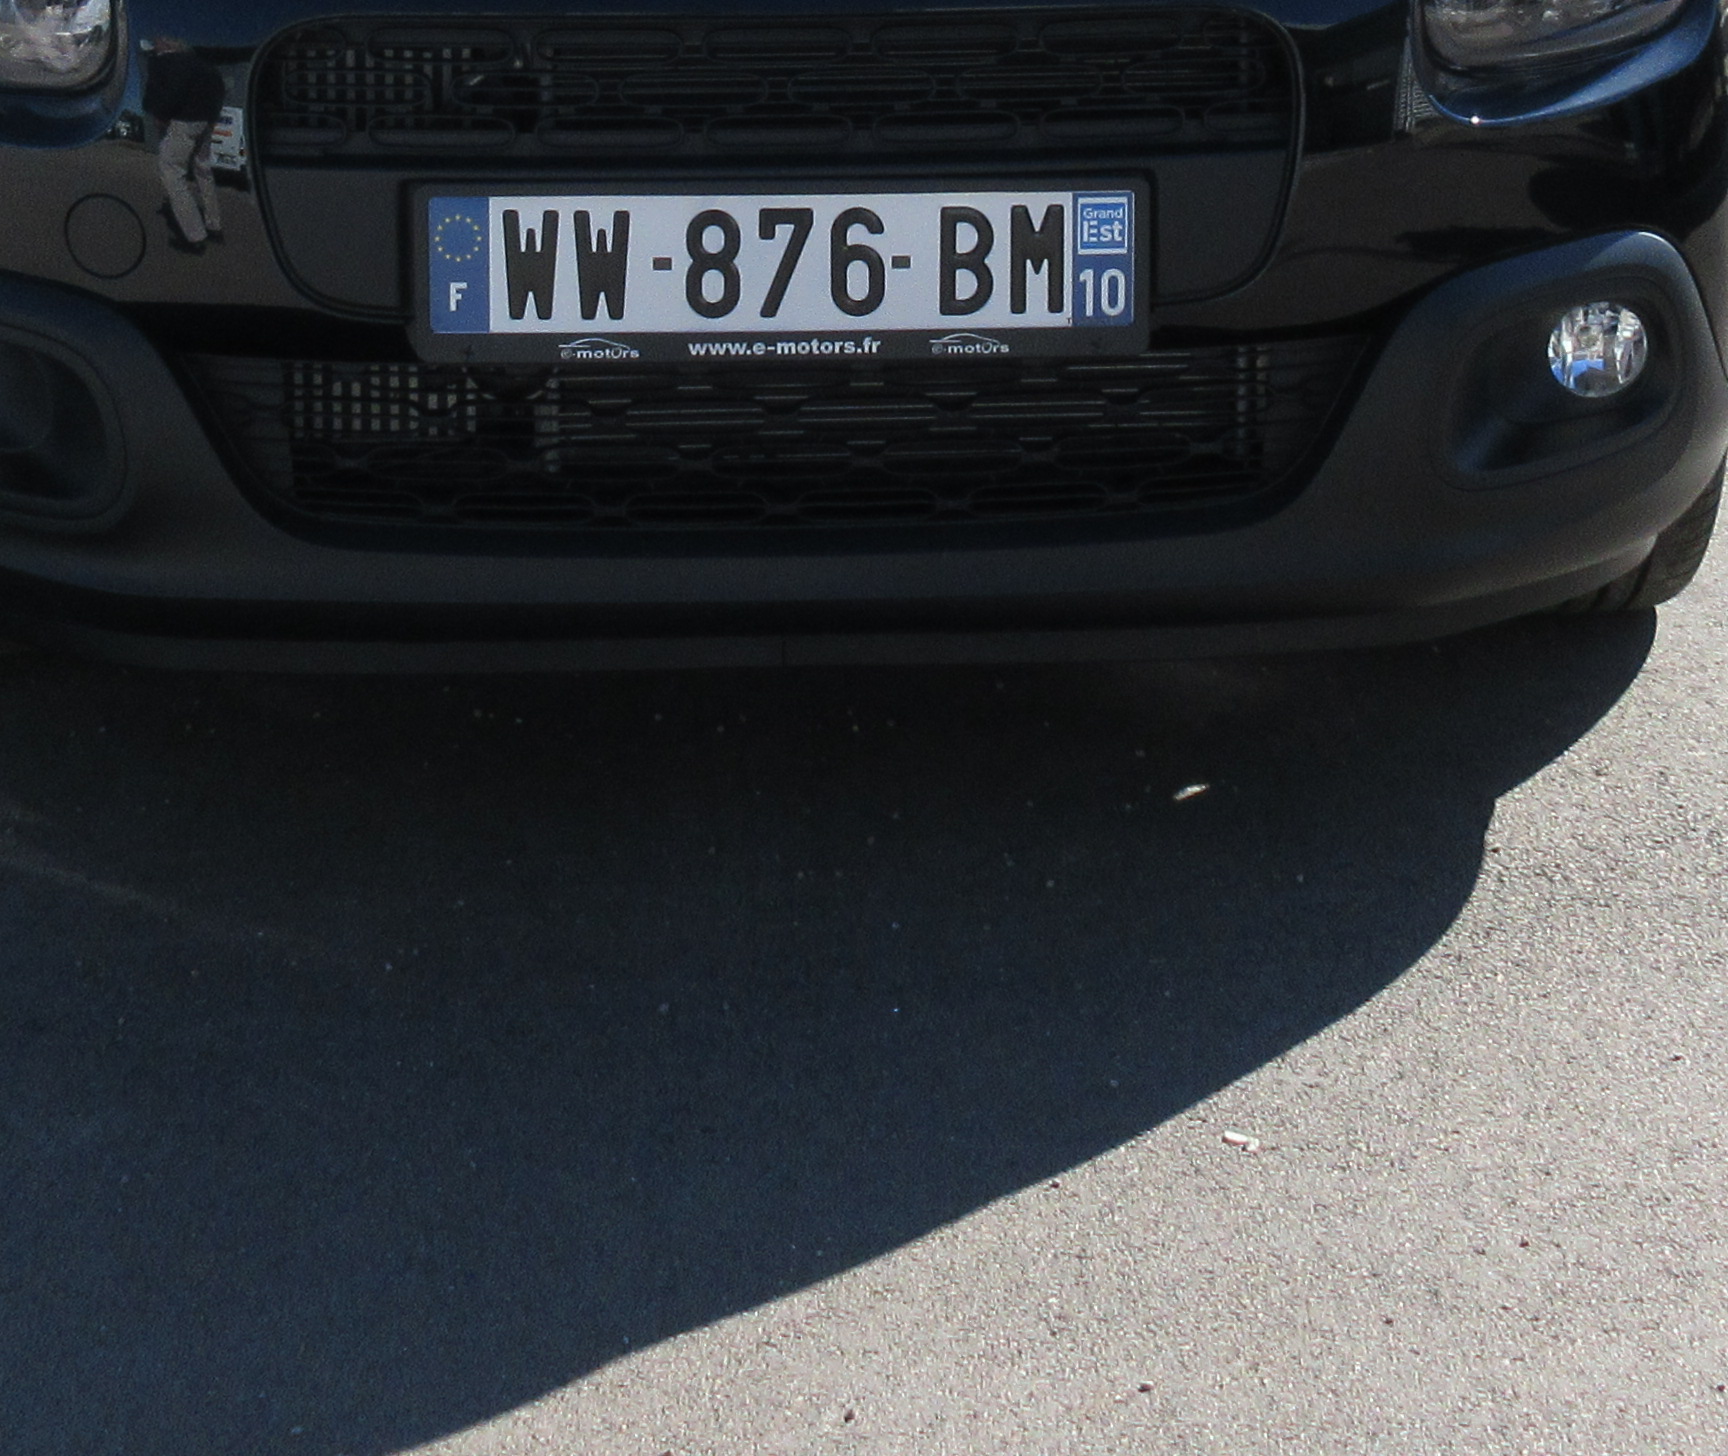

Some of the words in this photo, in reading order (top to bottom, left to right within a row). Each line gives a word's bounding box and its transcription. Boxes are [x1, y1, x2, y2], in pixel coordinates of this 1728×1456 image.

[1082, 207, 1124, 219] Grand
[1082, 220, 1124, 243] Est
[449, 282, 468, 312] F
[1079, 268, 1125, 317] 10
[687, 336, 881, 356] www.e-motors.fr
